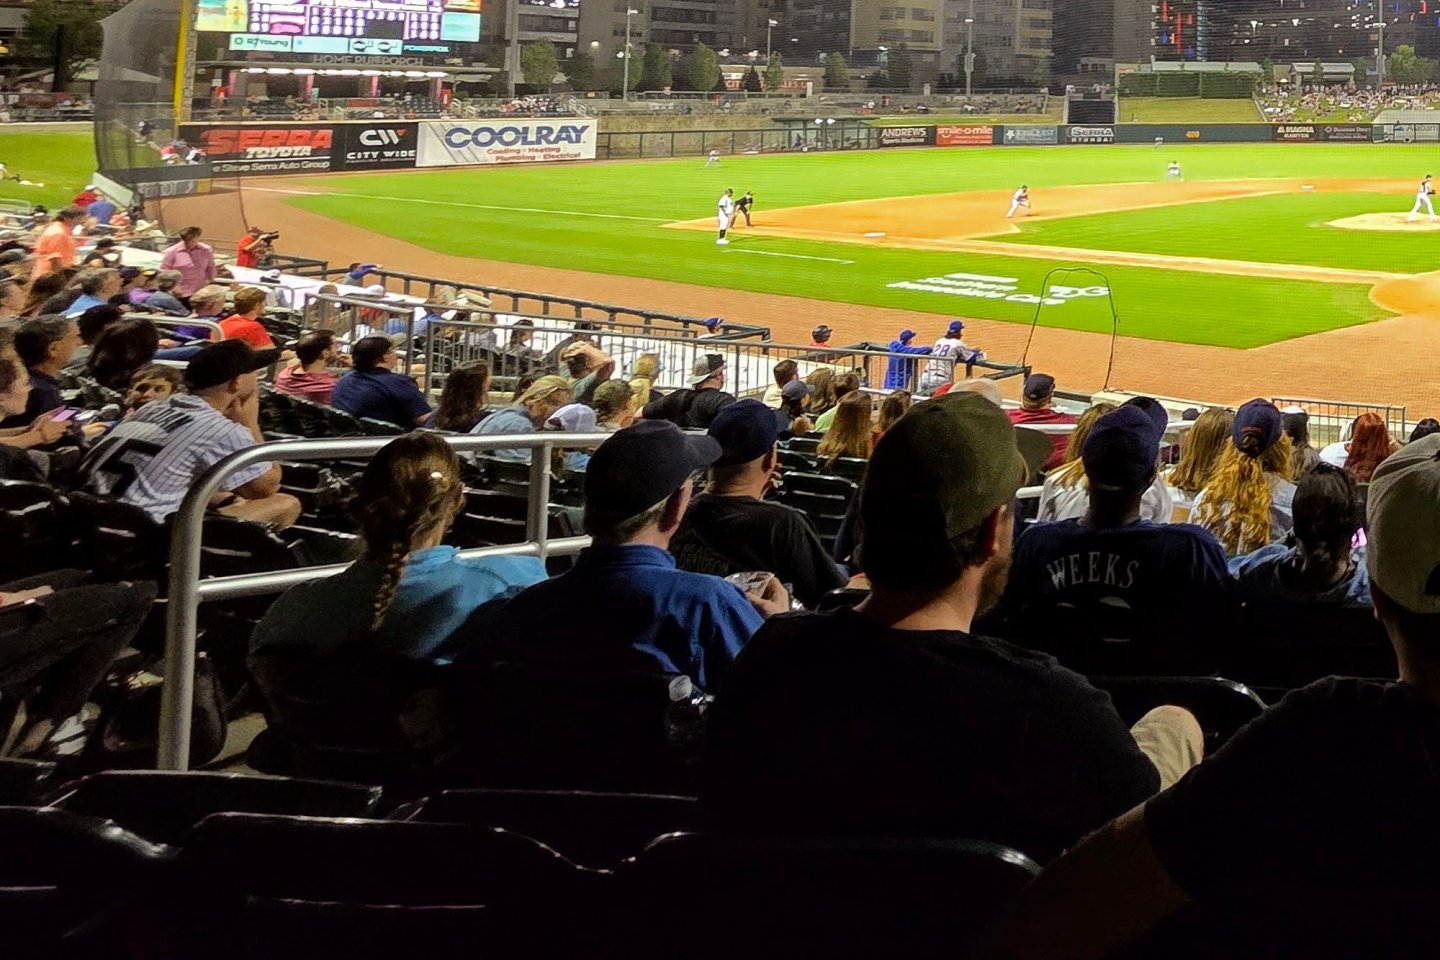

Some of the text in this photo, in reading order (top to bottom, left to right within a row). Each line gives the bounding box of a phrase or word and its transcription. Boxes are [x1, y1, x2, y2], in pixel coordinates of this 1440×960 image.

[313, 54, 352, 64] HOME
[381, 56, 423, 65] PORCH
[444, 125, 590, 149] COOLRAY
[881, 128, 926, 137] ANDREWS
[1071, 127, 1114, 137] SERRA
[200, 129, 333, 154] SERRA
[245, 146, 311, 158] TOYOTA
[347, 150, 416, 160] CITY WIDE
[487, 147, 560, 157] Cooling Heating
[495, 152, 580, 162] Plumbing Electrical
[222, 162, 250, 173] Steve
[251, 162, 277, 172] Serra
[278, 161, 300, 171] Auto
[301, 160, 330, 171] Group
[1046, 551, 1140, 590] WEEKS
